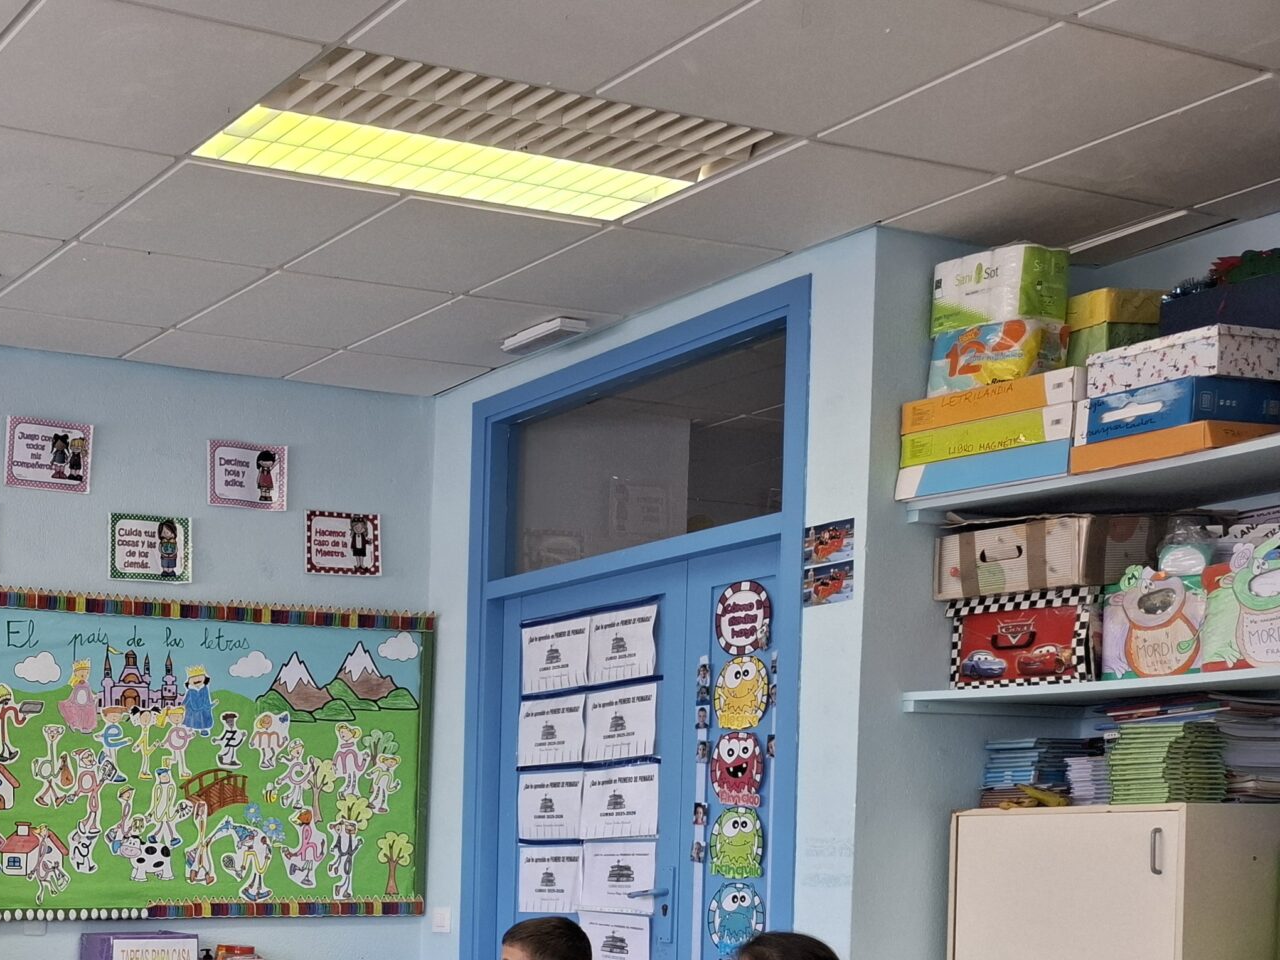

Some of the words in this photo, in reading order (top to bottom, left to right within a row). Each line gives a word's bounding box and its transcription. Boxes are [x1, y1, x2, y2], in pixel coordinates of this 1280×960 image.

[941, 383, 1014, 408] LETRILANDIA
[948, 443, 974, 456] LIBRO
[118, 528, 142, 537] Cuida
[315, 528, 346, 538] Hacemos
[331, 539, 340, 547] de
[6, 619, 39, 648] El
[127, 624, 145, 648] de
[166, 626, 184, 649] las
[200, 626, 251, 651] letras
